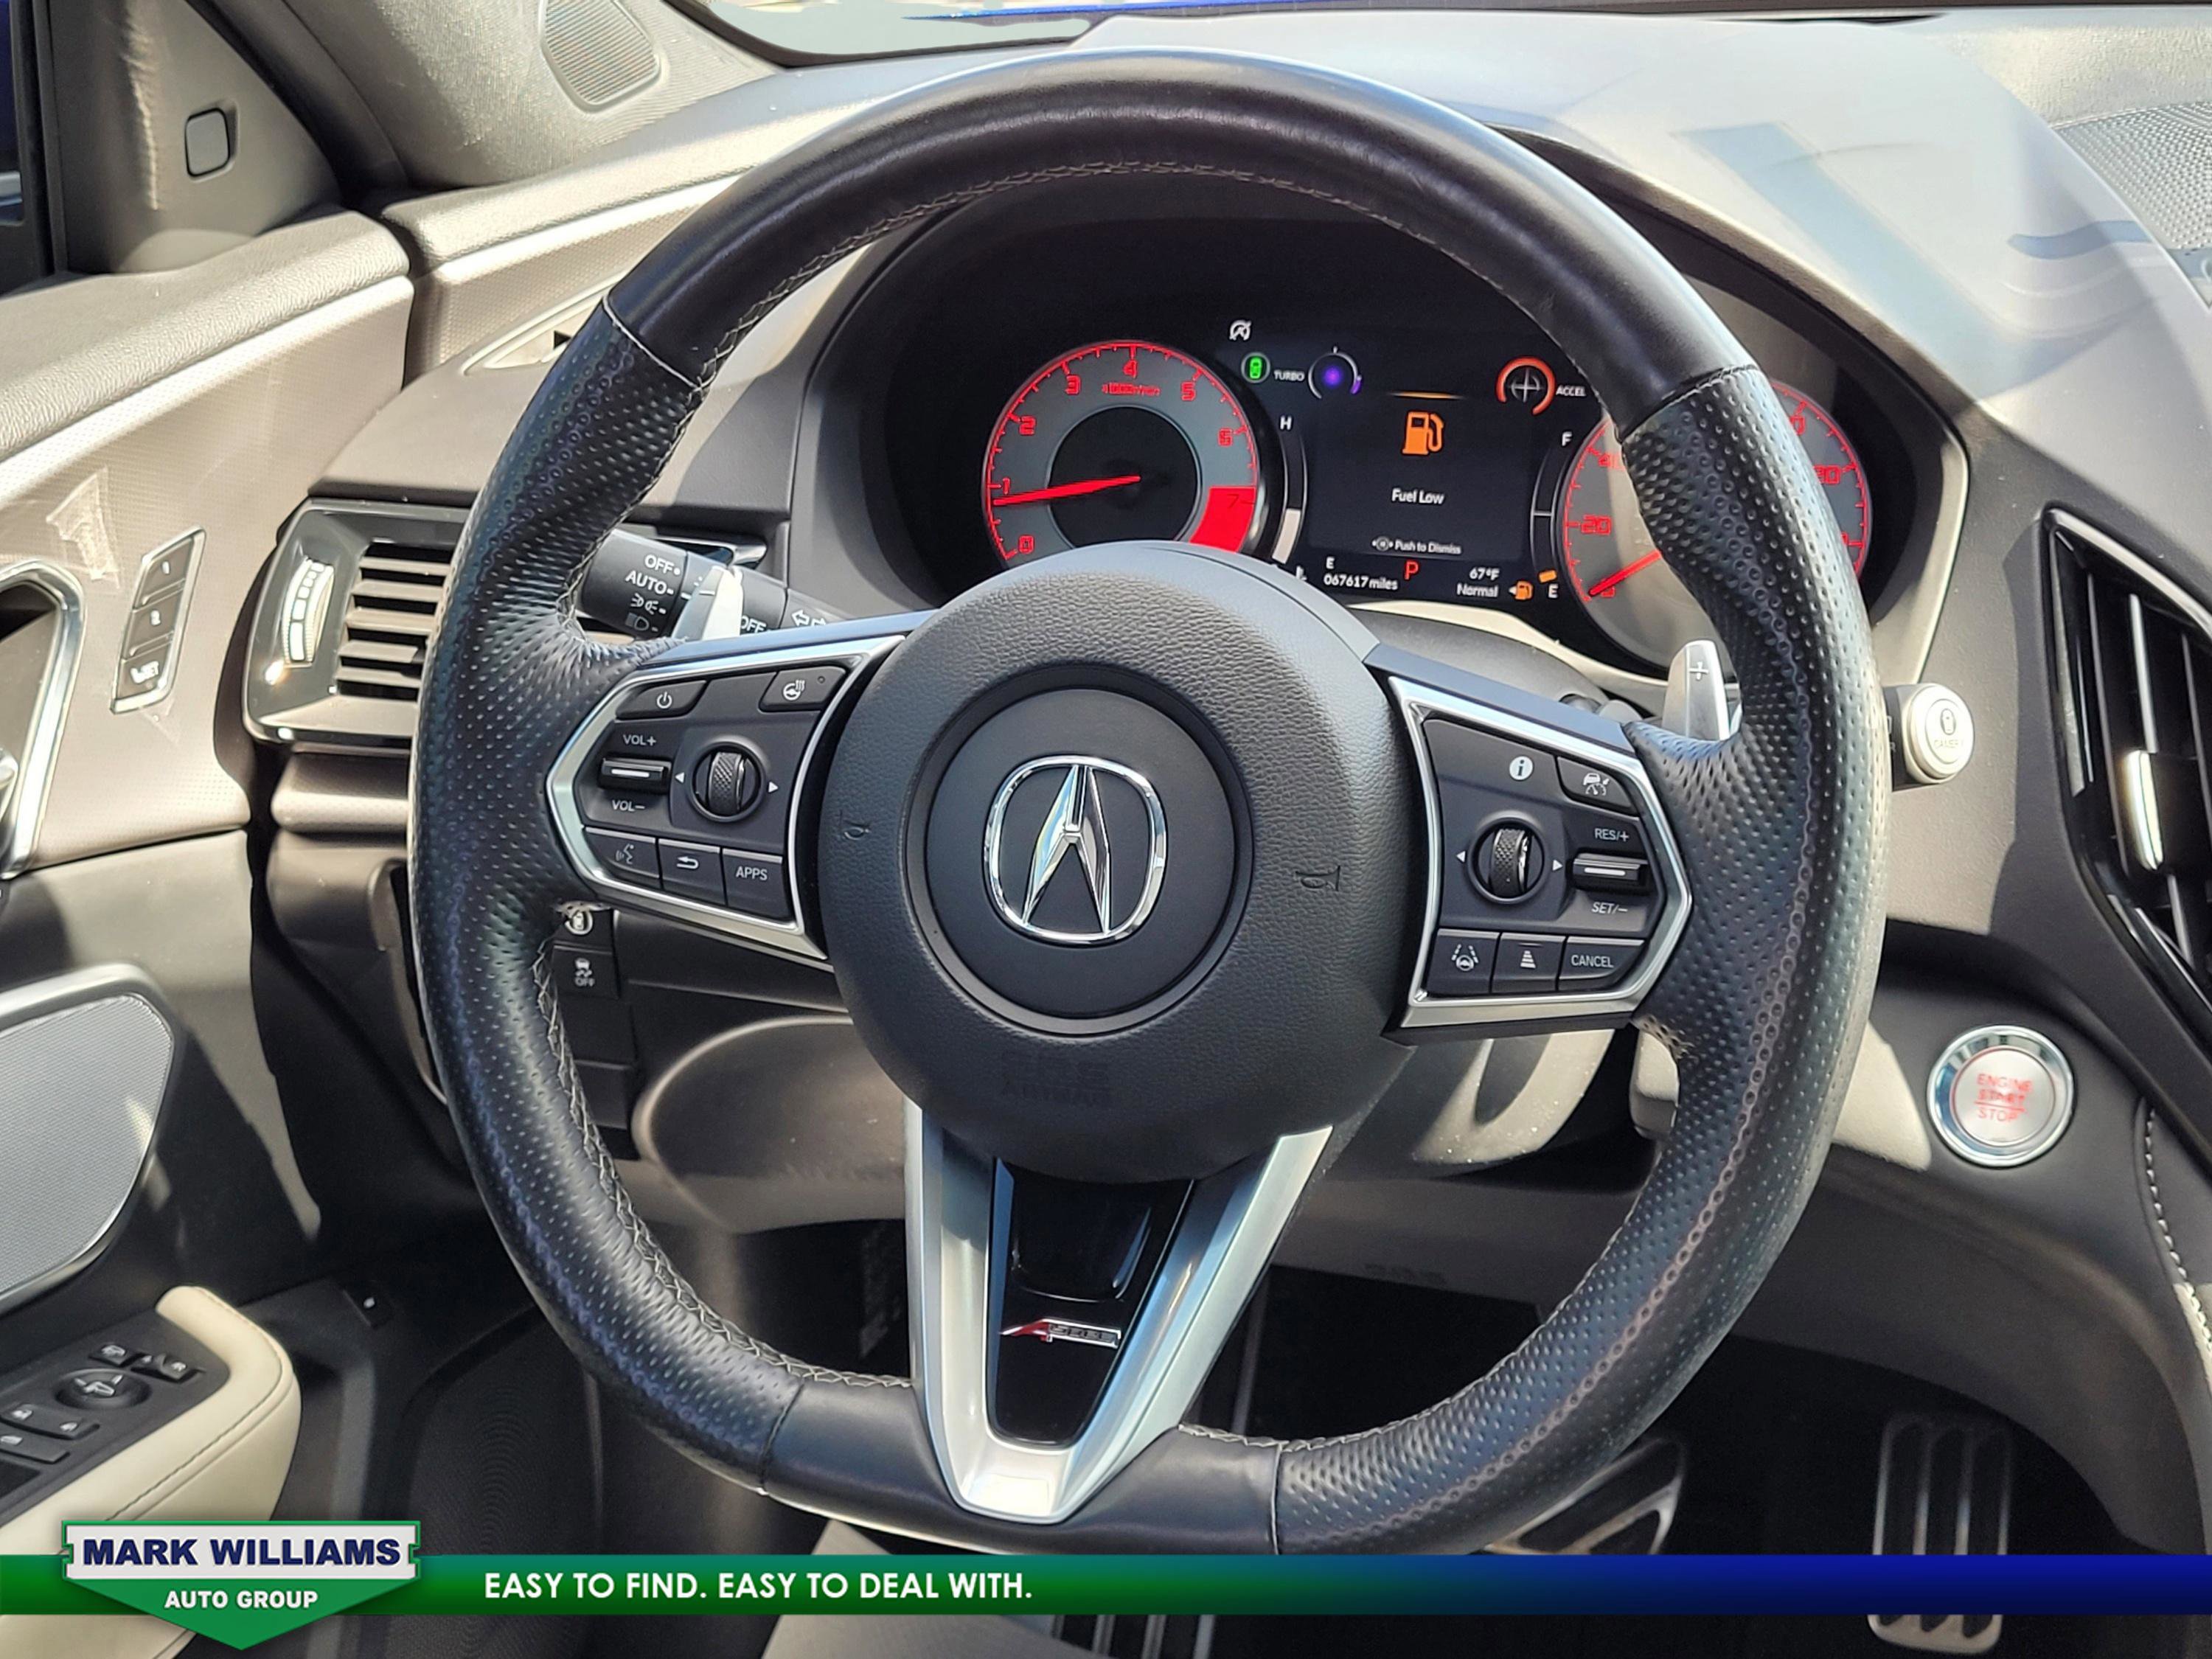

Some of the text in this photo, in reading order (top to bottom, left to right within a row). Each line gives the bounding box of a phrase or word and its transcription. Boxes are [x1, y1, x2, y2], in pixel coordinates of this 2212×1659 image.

[1123, 361, 1138, 378] 4
[1273, 370, 1304, 381] TURBO
[1066, 375, 1081, 394] 3
[1181, 382, 1196, 400] 5
[1556, 385, 1586, 397] ACCEL
[1019, 417, 1037, 435] 2
[1280, 416, 1292, 431] H
[1218, 429, 1233, 446] 6
[1562, 431, 1573, 447] F
[1002, 477, 1011, 494] 1
[1392, 489, 1444, 505] Fuel Low
[1581, 515, 1611, 535] 20
[1018, 535, 1034, 552] 0
[1395, 539, 1461, 554] Push to Dismiss
[644, 554, 674, 574] OFF
[1405, 560, 1419, 580] P
[625, 570, 667, 596] AUTO
[1324, 574, 1398, 591] 067617 miles
[1457, 582, 1498, 598] Normal
[1548, 584, 1558, 599] E
[736, 866, 768, 881] APPS
[1571, 954, 1614, 968] CANCEL
[1978, 1107, 2018, 1122] STOP
